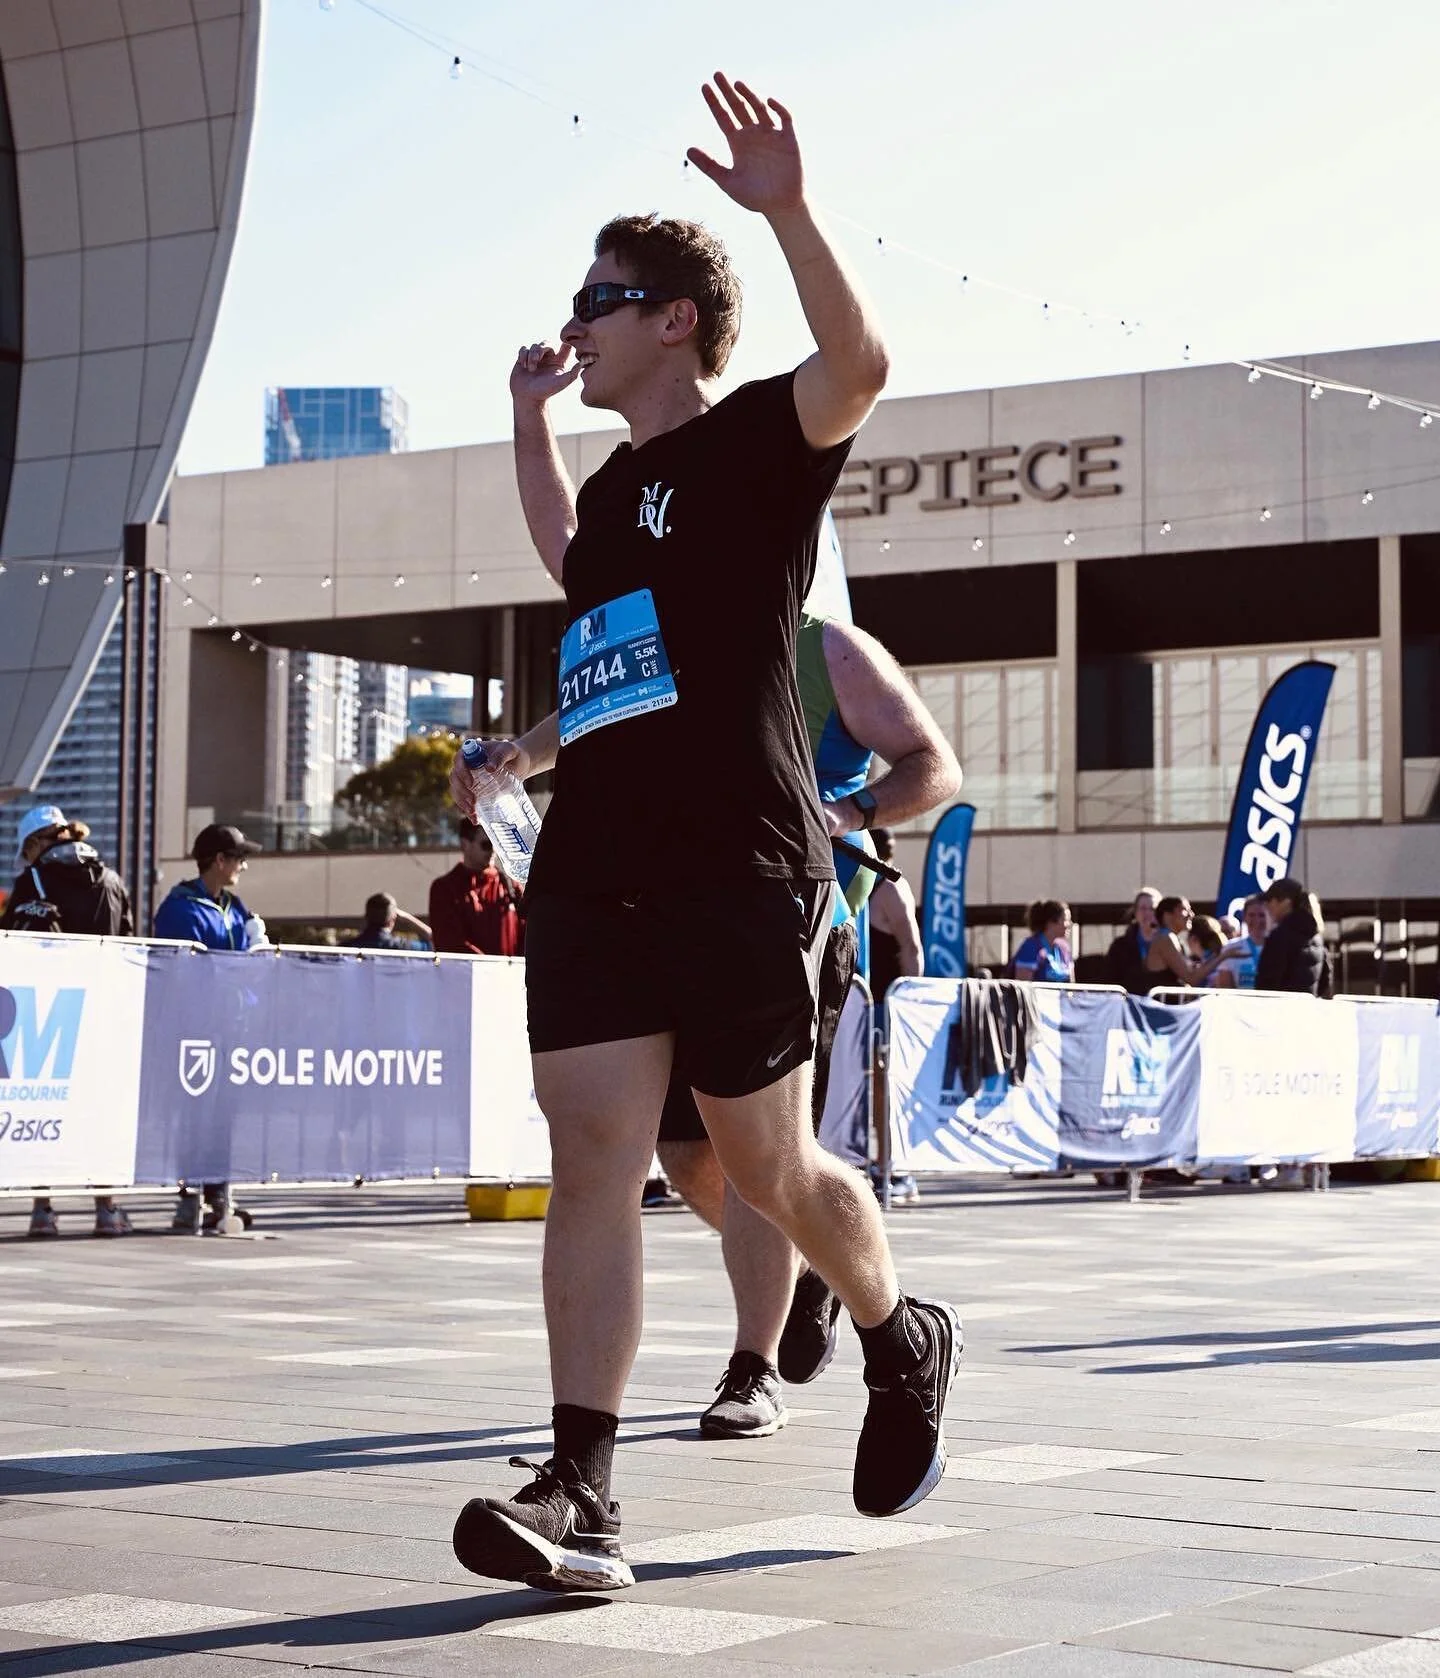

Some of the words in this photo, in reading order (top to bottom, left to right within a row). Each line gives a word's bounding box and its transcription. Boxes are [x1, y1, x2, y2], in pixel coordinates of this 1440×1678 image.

[580, 608, 606, 645] RM
[635, 645, 658, 660] 5.5K
[561, 653, 627, 709] 21744
[641, 662, 651, 677] C
[651, 696, 672, 708] 21744
[1240, 722, 1307, 893] asics
[933, 842, 961, 942] asics
[229, 1048, 314, 1087] SOLE
[323, 1049, 443, 1087] MOTIVE
[0, 1085, 70, 1101] LBOURNE
[11, 1119, 62, 1142] asics
